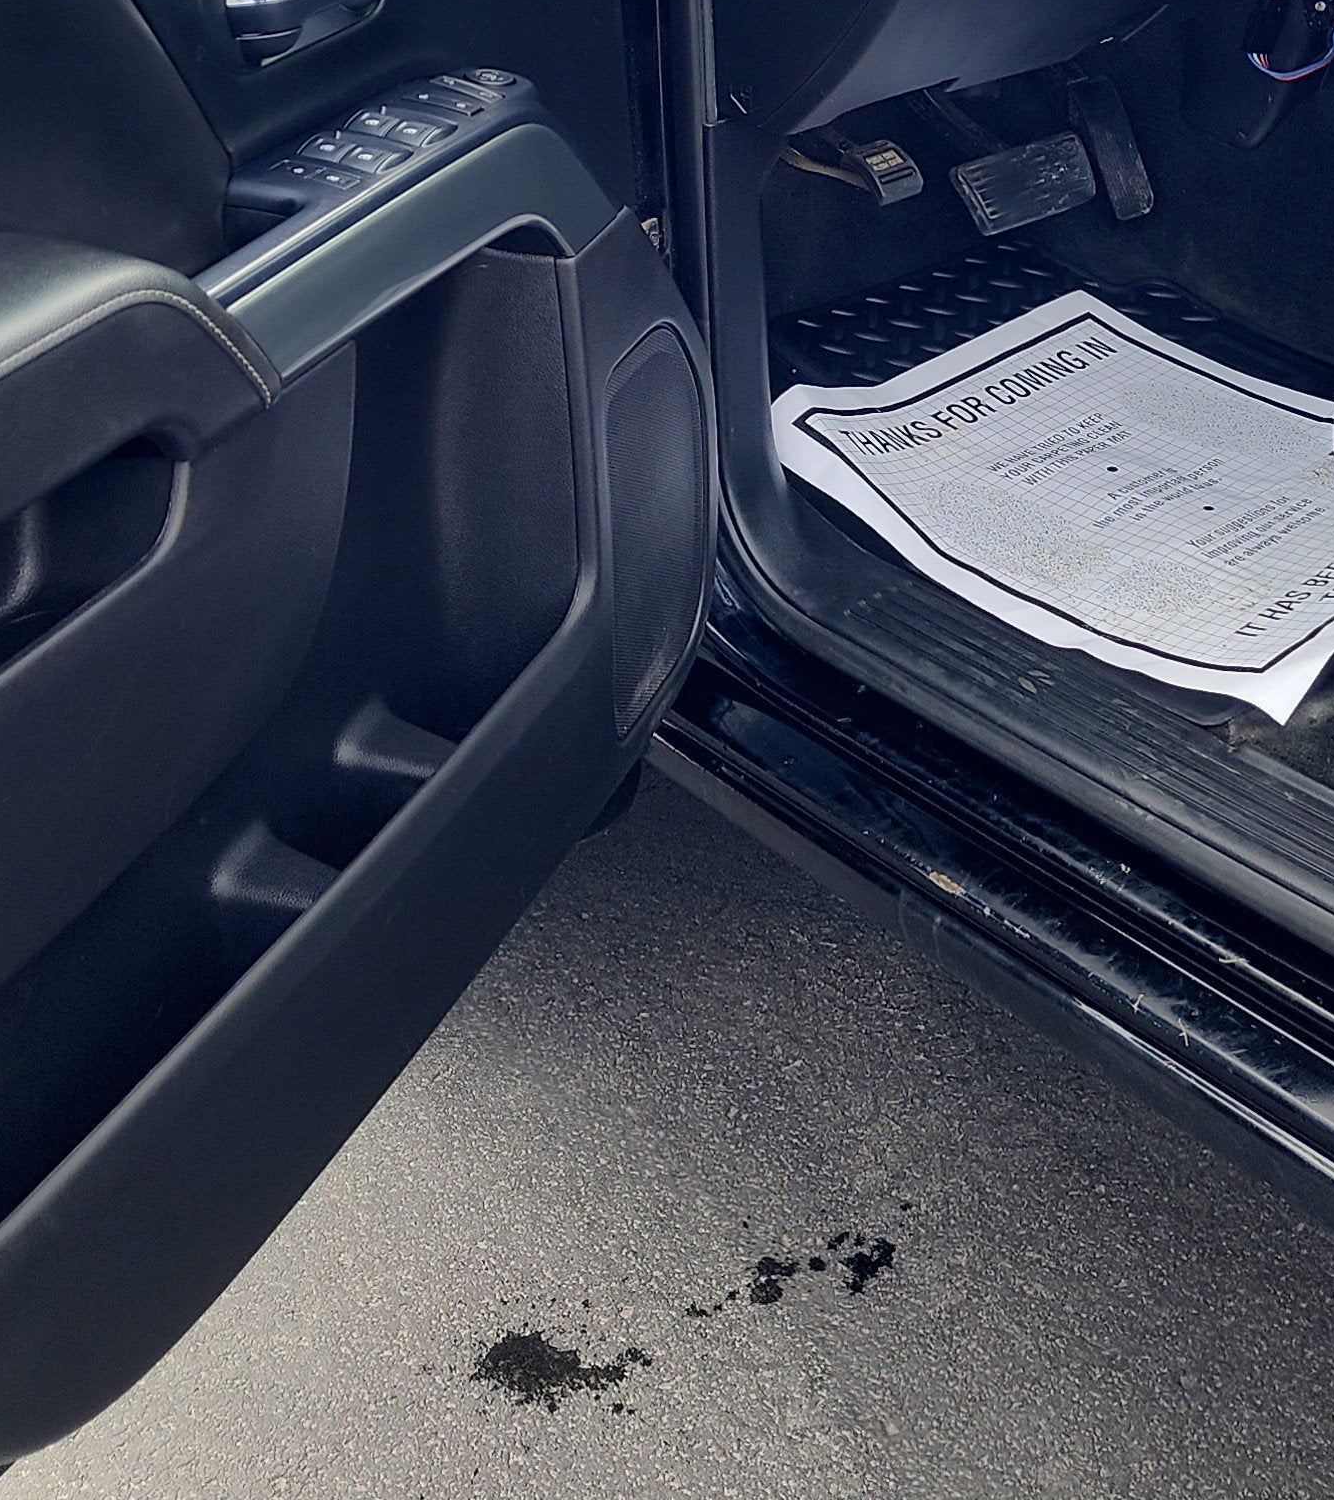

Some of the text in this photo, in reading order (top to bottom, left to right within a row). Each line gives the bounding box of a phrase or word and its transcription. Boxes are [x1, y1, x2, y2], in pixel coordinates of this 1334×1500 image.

[839, 337, 1118, 456] THANKS FOR COMING IN
[986, 412, 1105, 472] WE HAVE TRIED TO KEEP
[1003, 420, 1124, 481] YOUR CARPETING CLEAN
[1021, 466, 1056, 486] WITH
[1052, 453, 1079, 470] THIS
[1187, 458, 1224, 481] person
[1186, 533, 1218, 550] Your
[1224, 555, 1246, 567] are
[1234, 621, 1267, 637] IT
[1257, 590, 1312, 621] HAS
